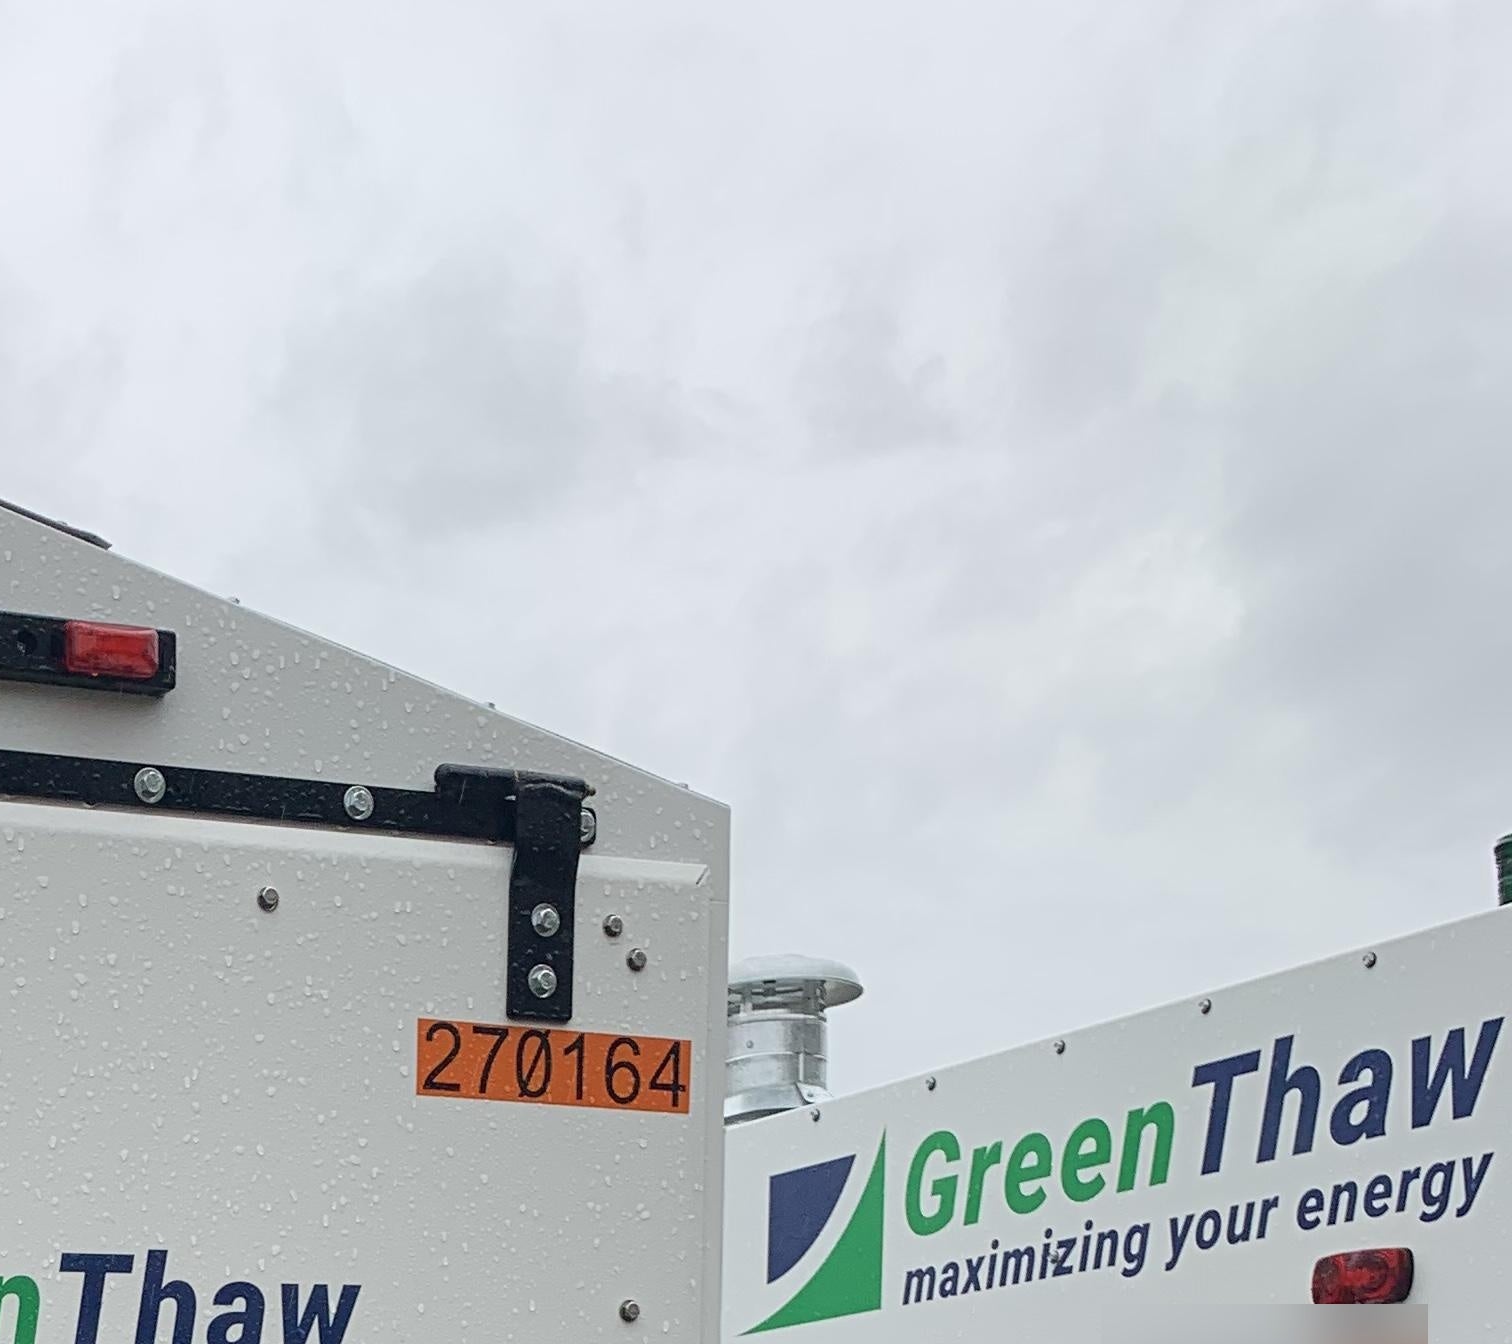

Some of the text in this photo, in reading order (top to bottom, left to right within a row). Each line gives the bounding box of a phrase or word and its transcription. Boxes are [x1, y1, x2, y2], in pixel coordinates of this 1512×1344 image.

[423, 1021, 686, 1108] 270164
[902, 1152, 1494, 1305] maximizing your energy
